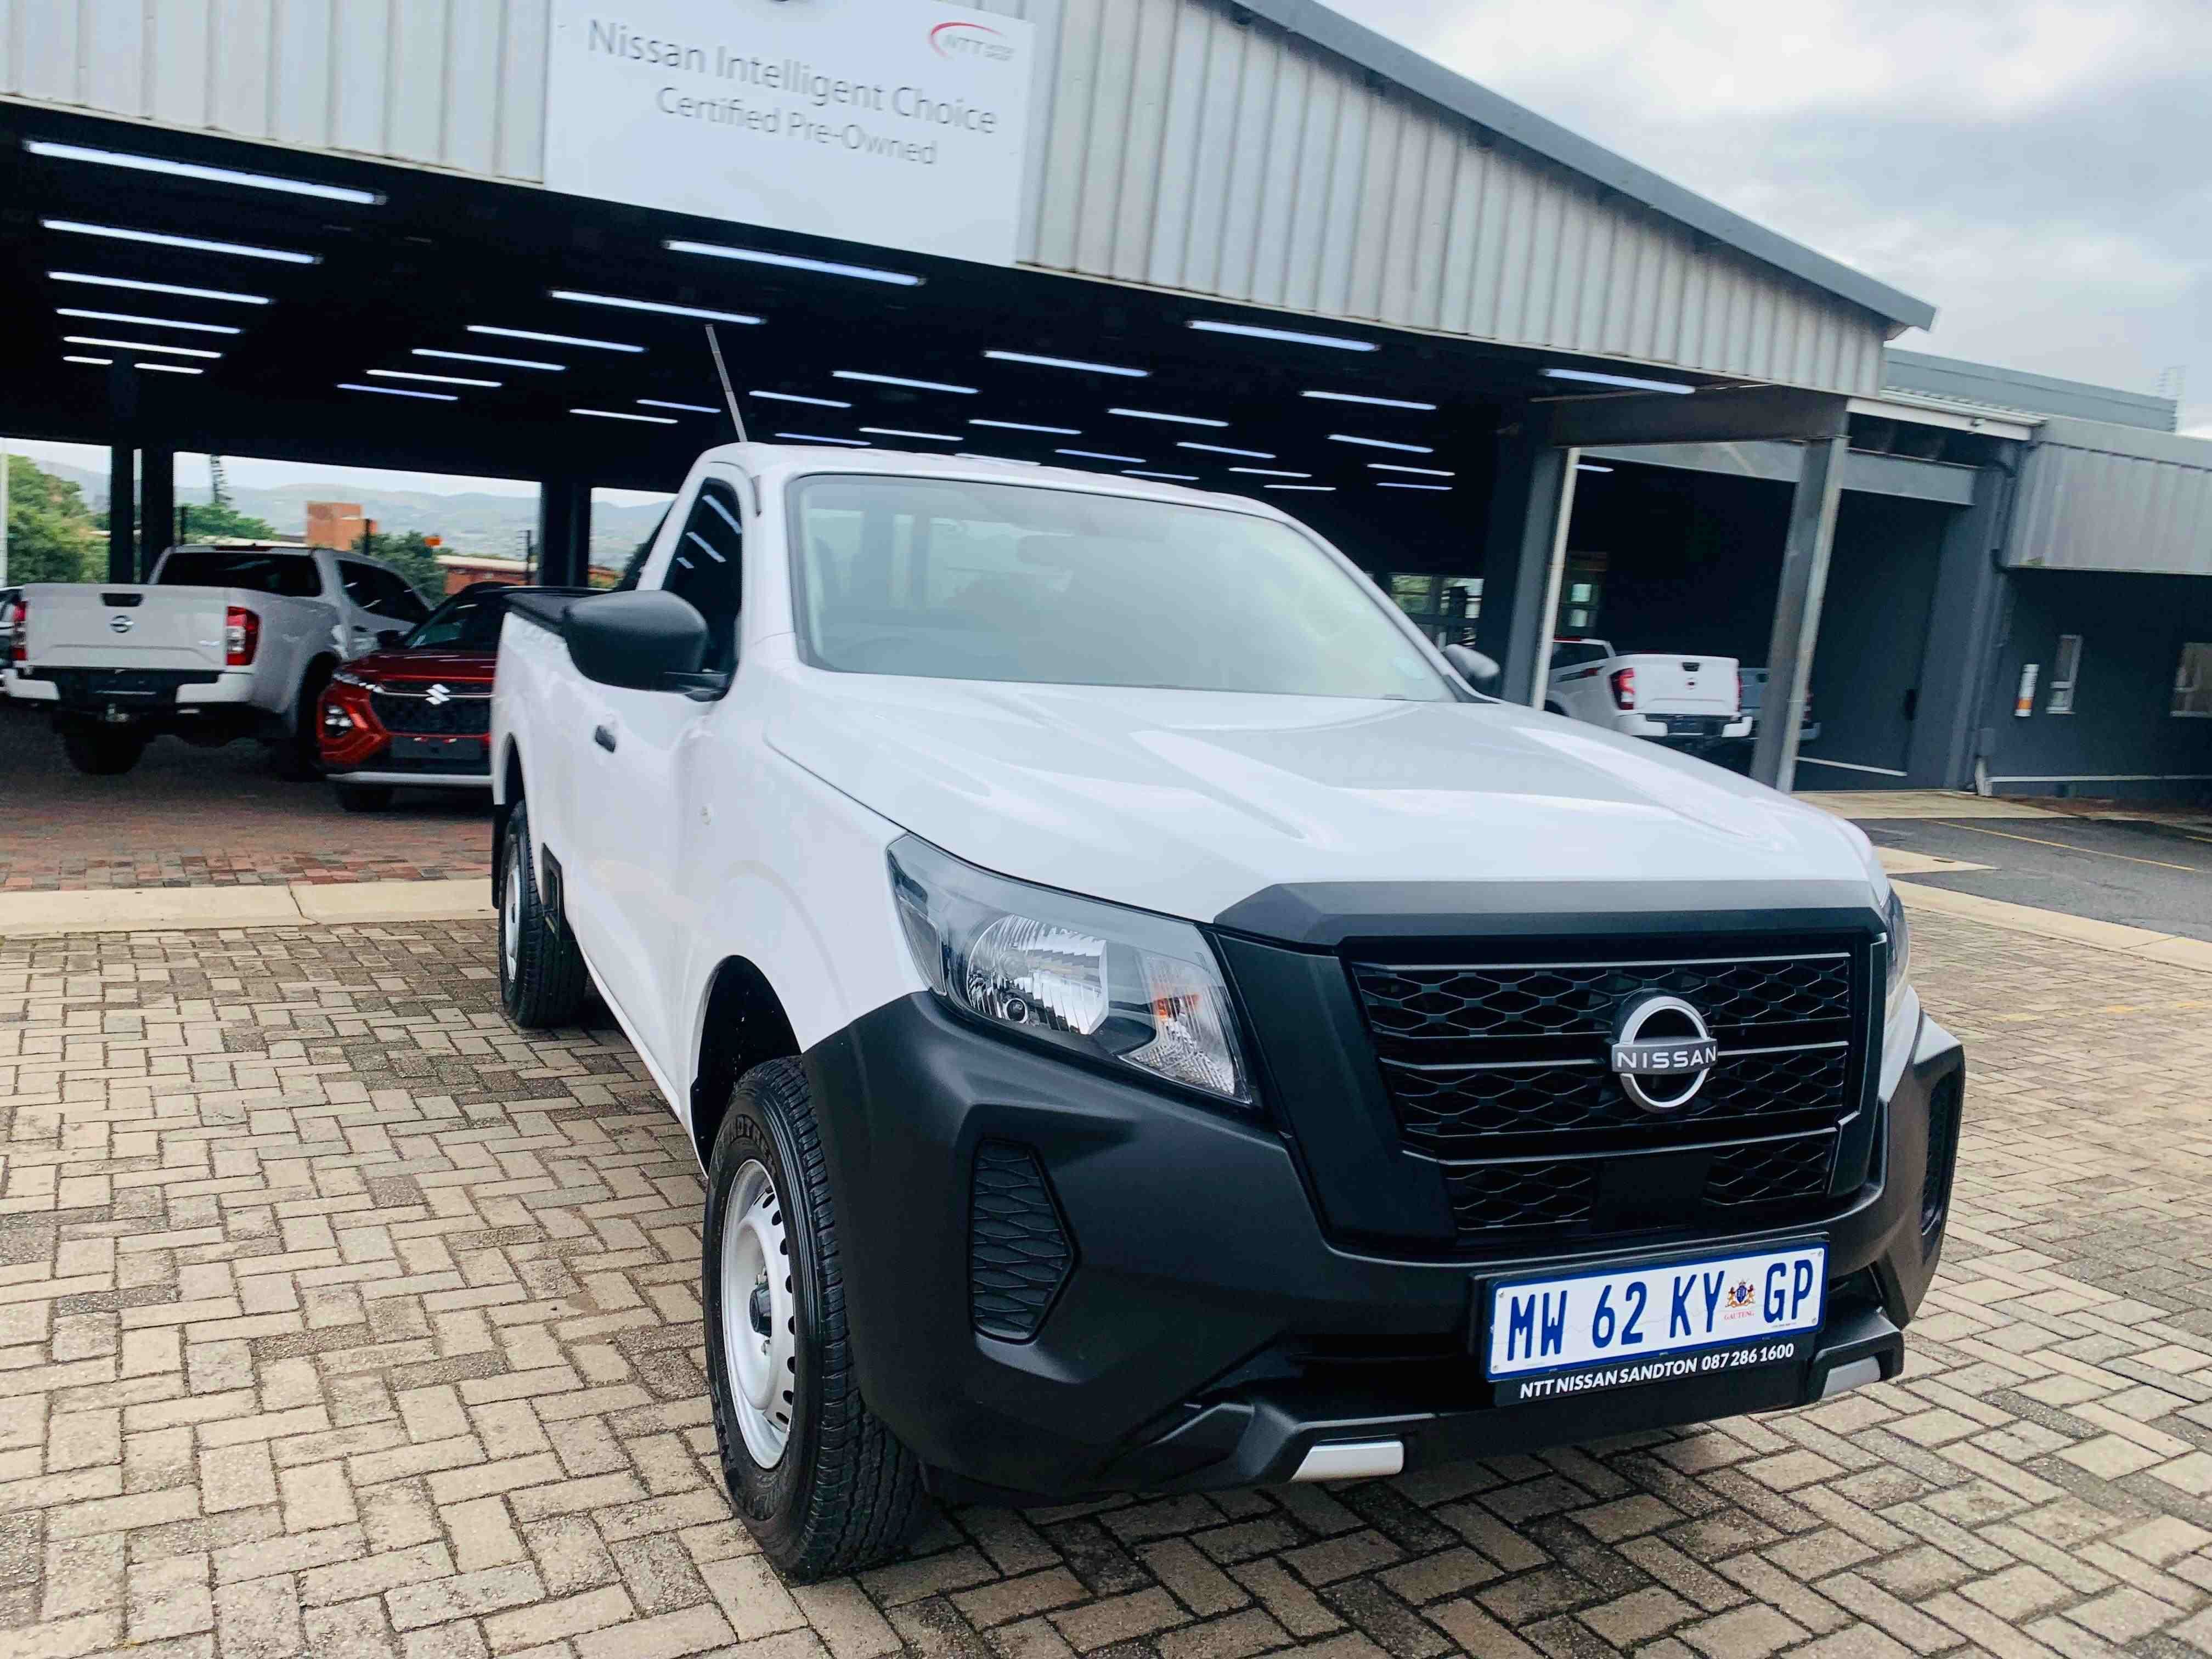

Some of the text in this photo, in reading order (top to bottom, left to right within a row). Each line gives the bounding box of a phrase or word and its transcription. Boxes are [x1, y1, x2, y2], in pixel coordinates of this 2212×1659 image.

[589, 19, 997, 134] Nissan Intelligent Choice
[657, 87, 938, 165] Certified Pre-Owned
[1618, 1046, 1716, 1069] NISSAN
[1507, 1259, 1813, 1361] MW 62 KY GP
[1519, 1343, 1795, 1399] NTT NISSAN SANDTON 087 286 1600
